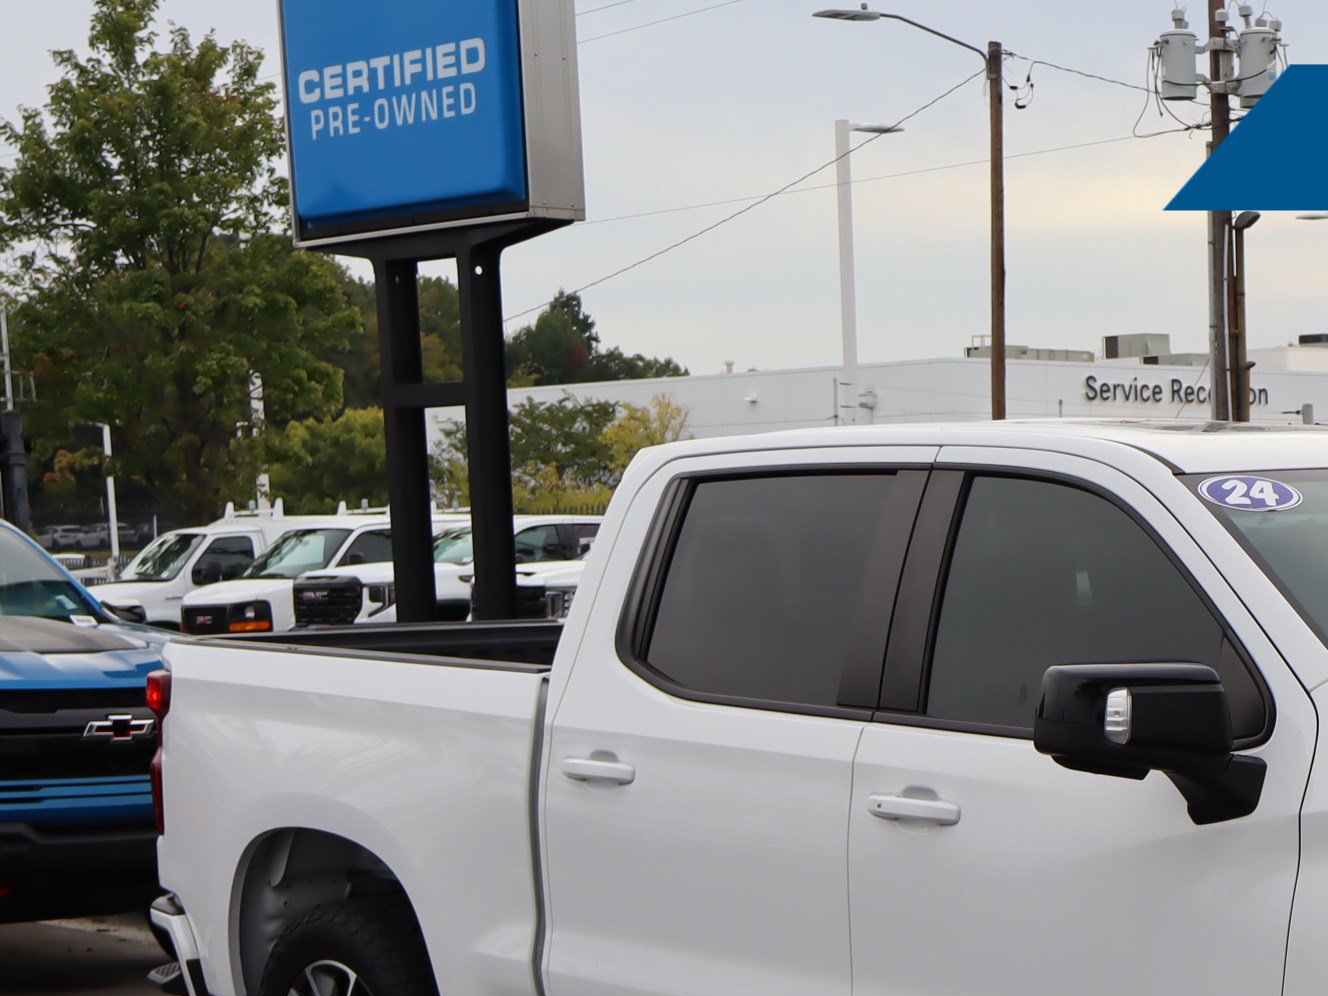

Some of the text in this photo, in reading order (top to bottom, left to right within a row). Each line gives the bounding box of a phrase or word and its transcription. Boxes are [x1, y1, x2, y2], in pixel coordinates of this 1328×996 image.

[298, 37, 486, 104] CERTIFIED
[311, 82, 477, 140] PRE-OWNED
[1085, 375, 1269, 406] Service Recon
[1221, 479, 1280, 507] 24
